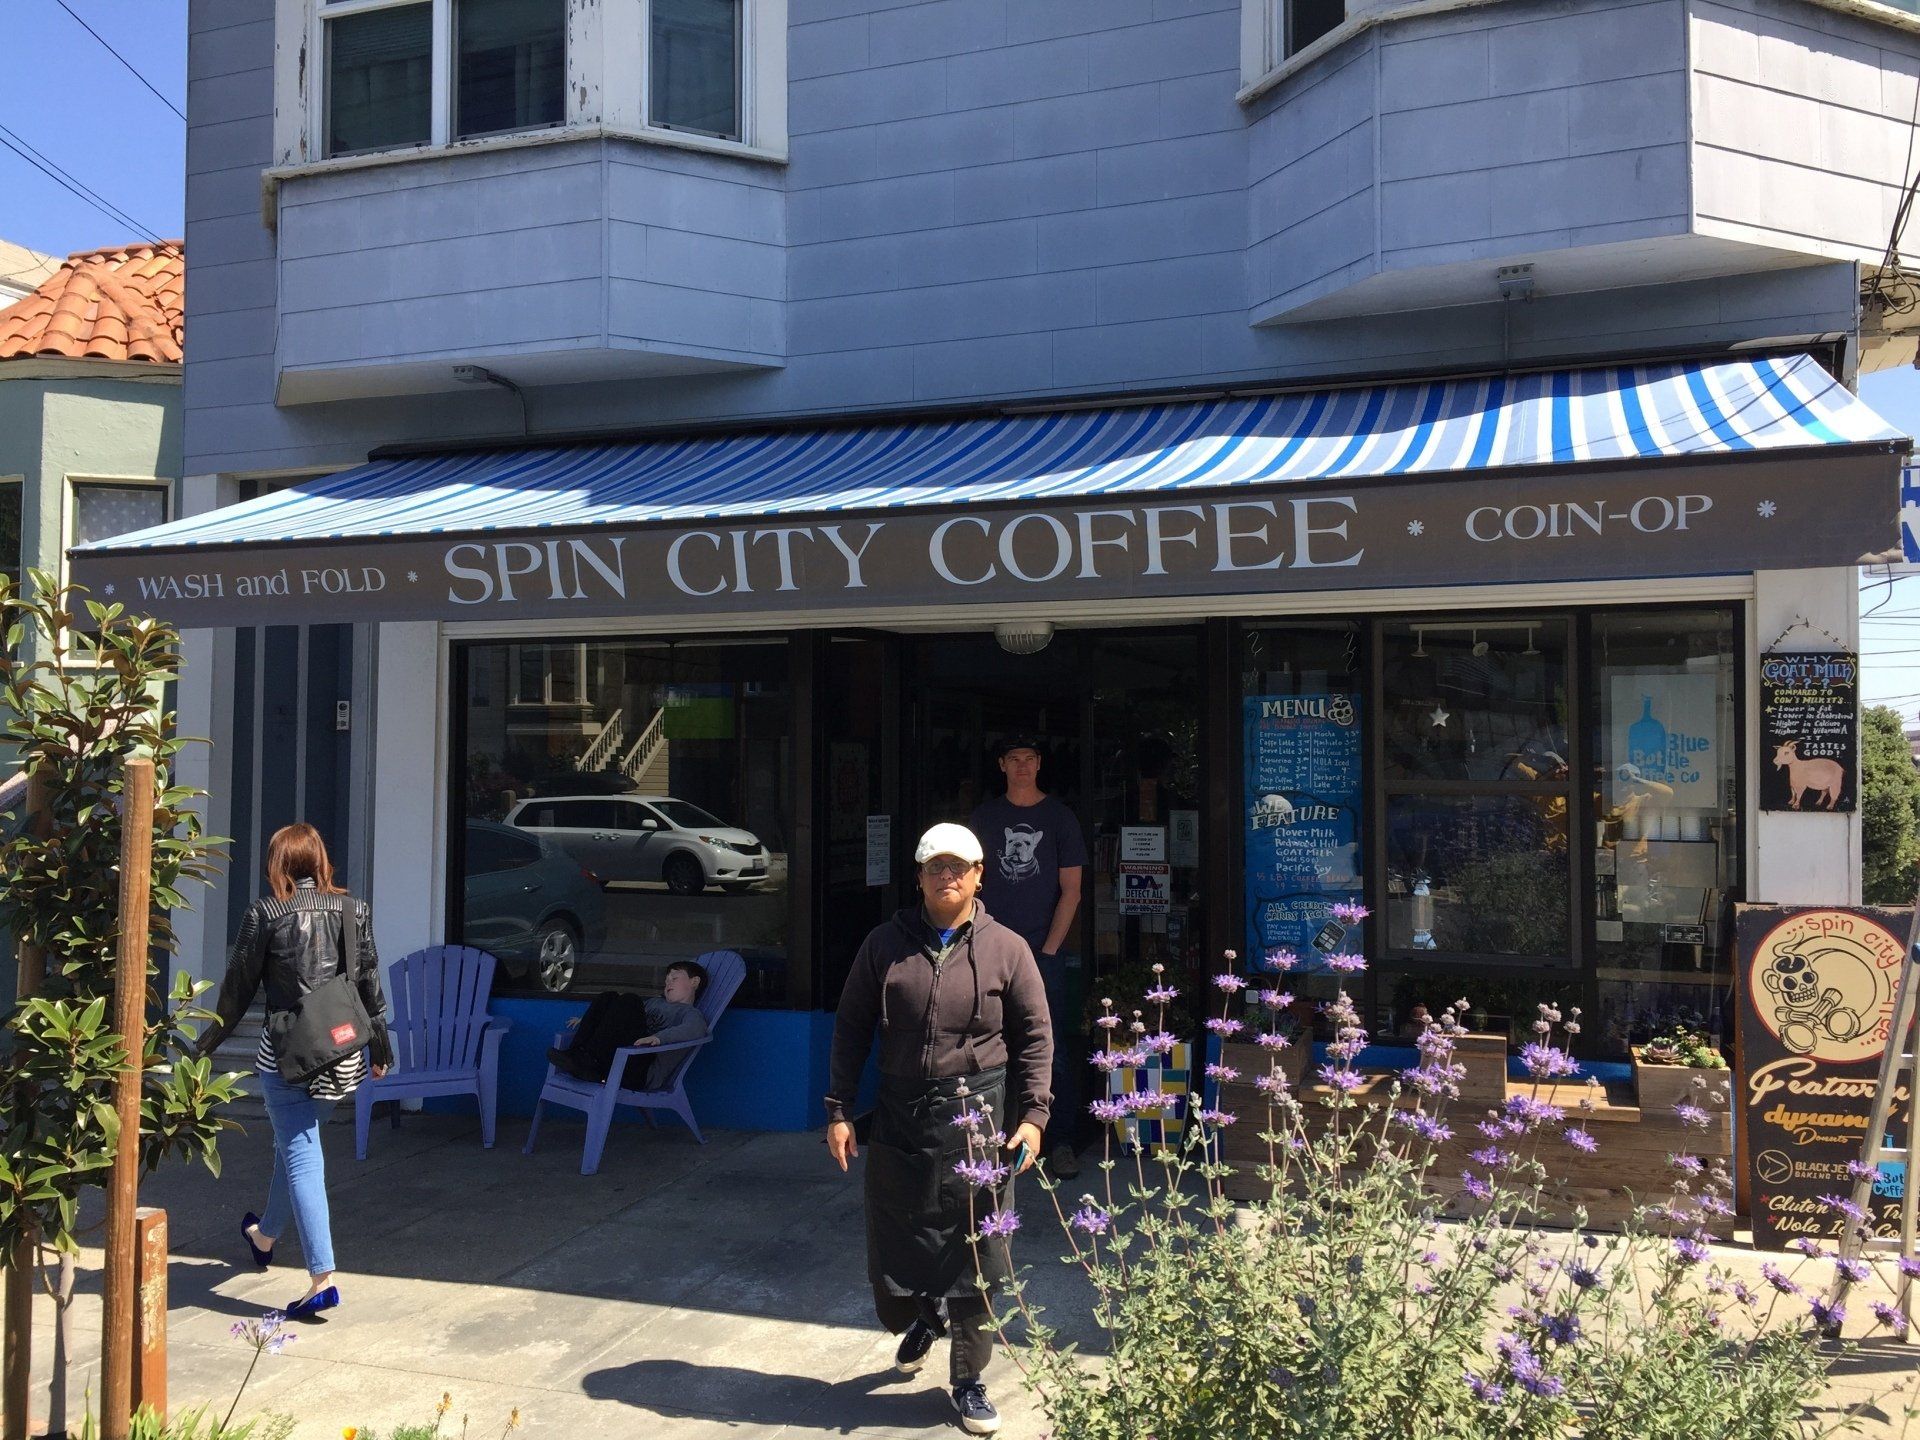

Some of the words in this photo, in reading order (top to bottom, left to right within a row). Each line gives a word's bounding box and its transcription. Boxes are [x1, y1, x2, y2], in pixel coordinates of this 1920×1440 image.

[1464, 493, 1714, 542] COIN-OP
[443, 536, 627, 605] SPIN
[666, 522, 886, 597] CITY
[928, 496, 1365, 586] COFFEE
[137, 569, 225, 600] WASH
[235, 567, 290, 596] and
[301, 566, 387, 595] FOLD
[1784, 655, 1832, 663] WHY
[1765, 663, 1810, 679] GOAT
[1813, 664, 1853, 681] MILK
[1774, 688, 1818, 696] COMPARED
[1820, 688, 1833, 696] TO
[1260, 698, 1327, 719] MENU
[1668, 732, 1710, 753] Blue
[1803, 742, 1847, 750] TASTES
[1632, 748, 1690, 770] Bottle
[1803, 749, 1841, 758] GOOD!
[1251, 799, 1285, 815] WE
[1250, 805, 1340, 831] FEATURE
[1275, 827, 1310, 837] Clover
[1310, 828, 1336, 837] Milk
[1274, 837, 1317, 848] Redwood
[1319, 838, 1338, 849] Hill
[1275, 848, 1304, 856] GOAT
[1275, 862, 1311, 875] Pacific
[1313, 864, 1333, 879] Soy
[1125, 889, 1151, 898] DETECT
[1151, 889, 1164, 899] ALL
[1267, 902, 1288, 913] ALL
[1264, 911, 1299, 922] CARDS
[1863, 932, 1901, 970] city
[1763, 1103, 1871, 1131] dynam
[1794, 1161, 1829, 1172] BLACK
[1794, 1172, 1831, 1180] BAKING
[1768, 1194, 1830, 1215] Gluten
[1774, 1214, 1822, 1234] Nola
